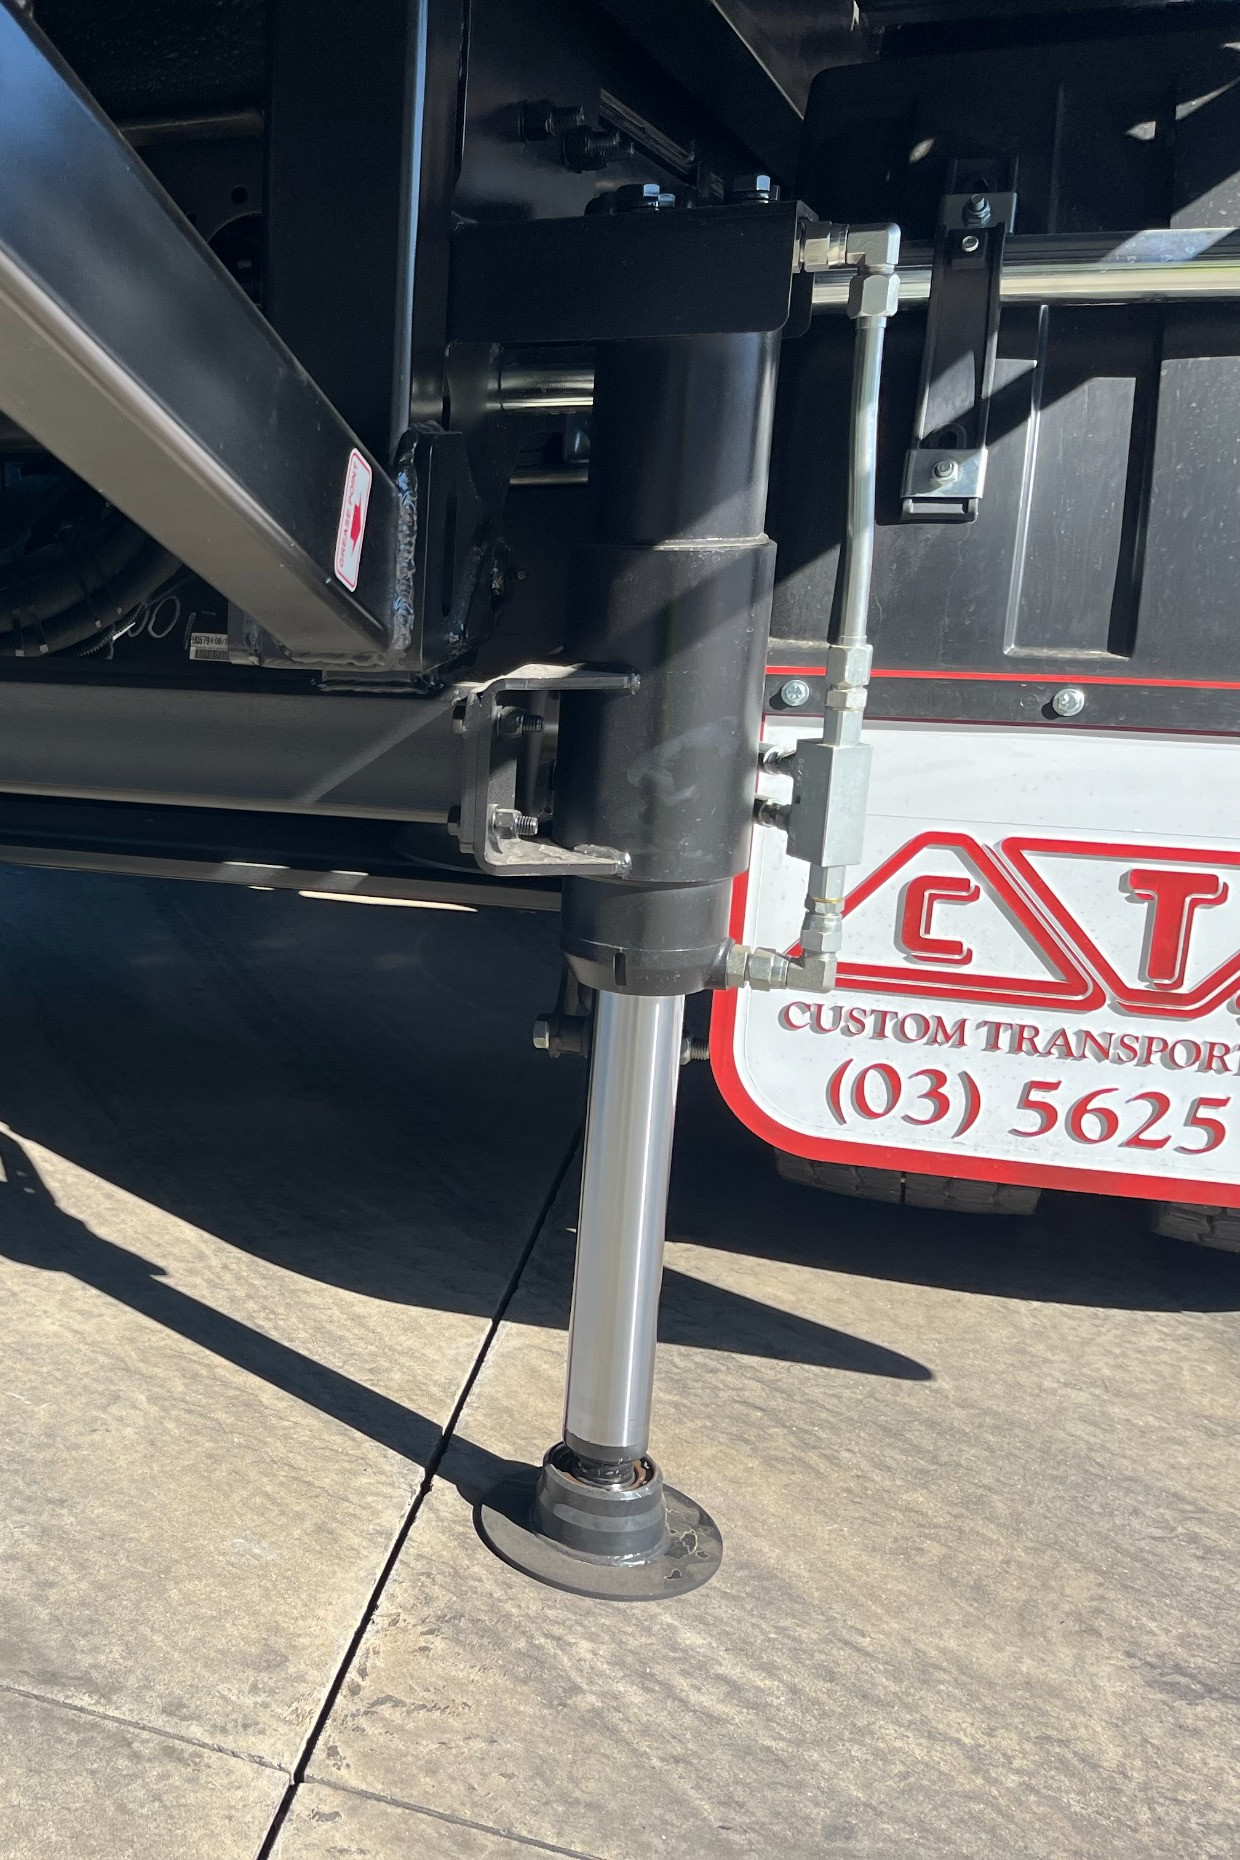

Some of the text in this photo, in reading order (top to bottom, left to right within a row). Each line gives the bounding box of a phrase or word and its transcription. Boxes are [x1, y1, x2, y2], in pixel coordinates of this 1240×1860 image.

[339, 461, 359, 568] GREASE POINT
[894, 868, 1229, 992] C T
[778, 1000, 969, 1049] CUSTOM
[826, 1058, 1232, 1156] (03) 5625
